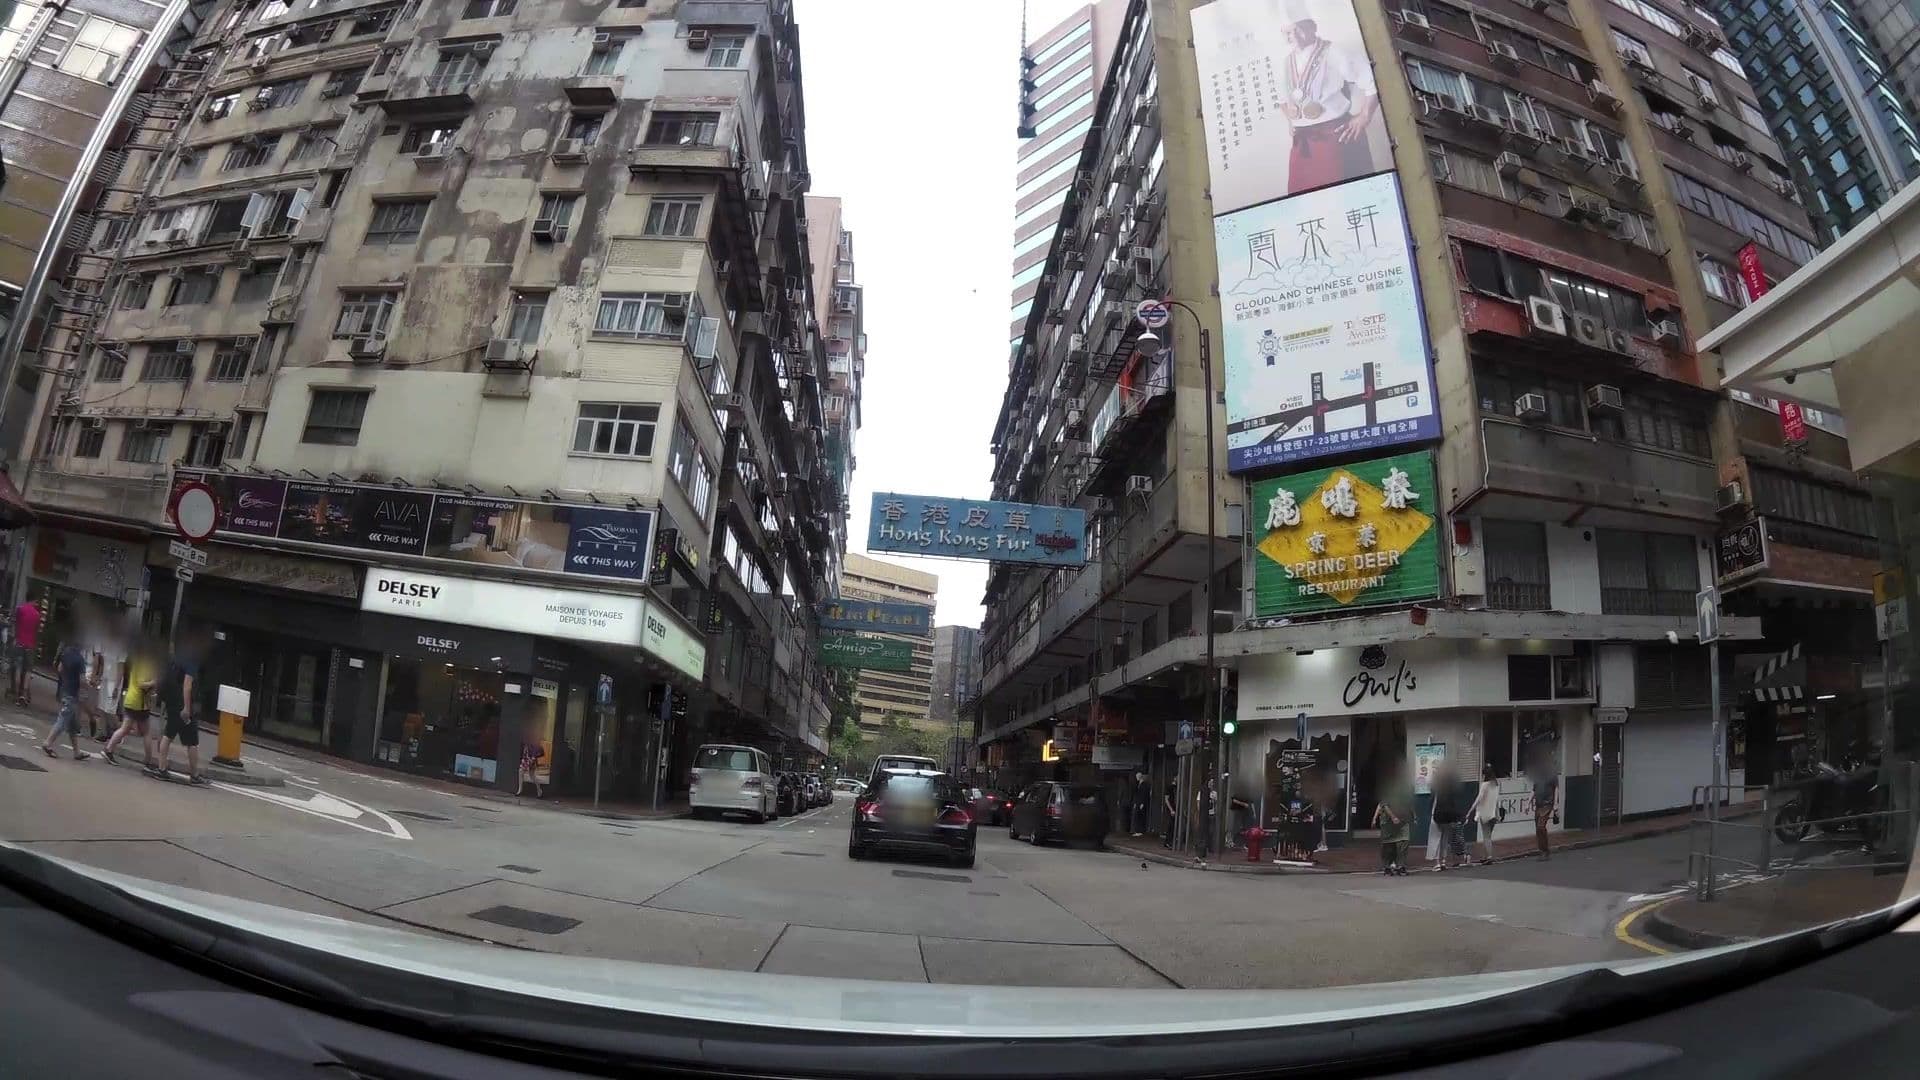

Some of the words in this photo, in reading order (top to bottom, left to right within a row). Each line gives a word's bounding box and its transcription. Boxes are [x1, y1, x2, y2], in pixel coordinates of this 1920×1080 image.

[1234, 289, 1301, 312] CLOUDLAND
[1305, 276, 1353, 295] CHINESE
[1357, 266, 1403, 283] CUISINE
[1344, 313, 1387, 330] TSTE
[1348, 325, 1386, 340] Awards
[1297, 424, 1313, 433] K11
[374, 500, 421, 522] AVA
[879, 499, 1031, 532] 香港皮草
[245, 518, 258, 527] THIS
[259, 519, 274, 529] WAY
[382, 534, 400, 544] THIS
[401, 536, 420, 546] WAY
[879, 523, 933, 547] Hong
[939, 528, 990, 552] Kong
[995, 534, 1030, 551] Fur
[591, 557, 612, 567] THIS
[613, 558, 639, 570] WAY
[1284, 556, 1347, 580] SPRING
[1353, 549, 1401, 571] DEER
[378, 579, 441, 600] DELSEY
[1298, 574, 1387, 597] RESTAURANT
[392, 597, 422, 608] PARIS
[545, 604, 576, 615] MAISON
[576, 607, 588, 616] DE
[588, 608, 624, 621] VOYAGES
[559, 614, 587, 626] DEPUIS
[587, 617, 607, 628] 1946
[647, 615, 667, 640] DELSEY
[417, 635, 461, 650] DELSEY
[823, 637, 885, 656] Amigo
[533, 680, 556, 691] DELSEY
[1343, 659, 1417, 708] Owl's
